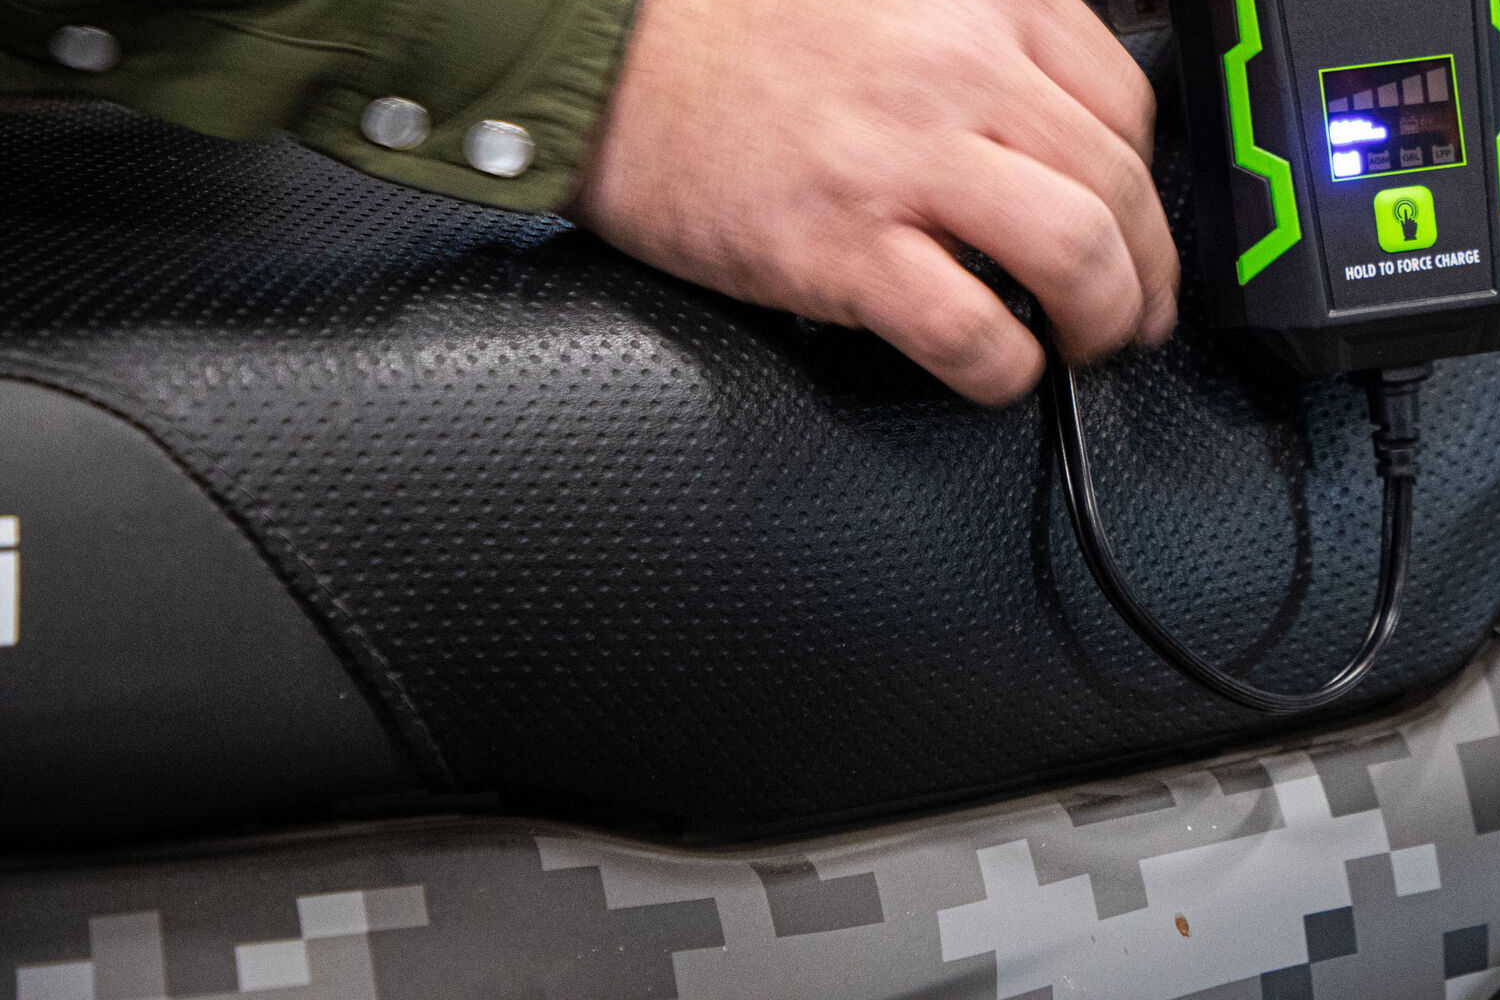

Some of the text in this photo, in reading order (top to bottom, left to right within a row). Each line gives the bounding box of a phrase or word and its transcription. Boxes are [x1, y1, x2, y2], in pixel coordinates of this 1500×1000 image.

[1345, 249, 1481, 280] HOLD TO FORCE CHARGE
